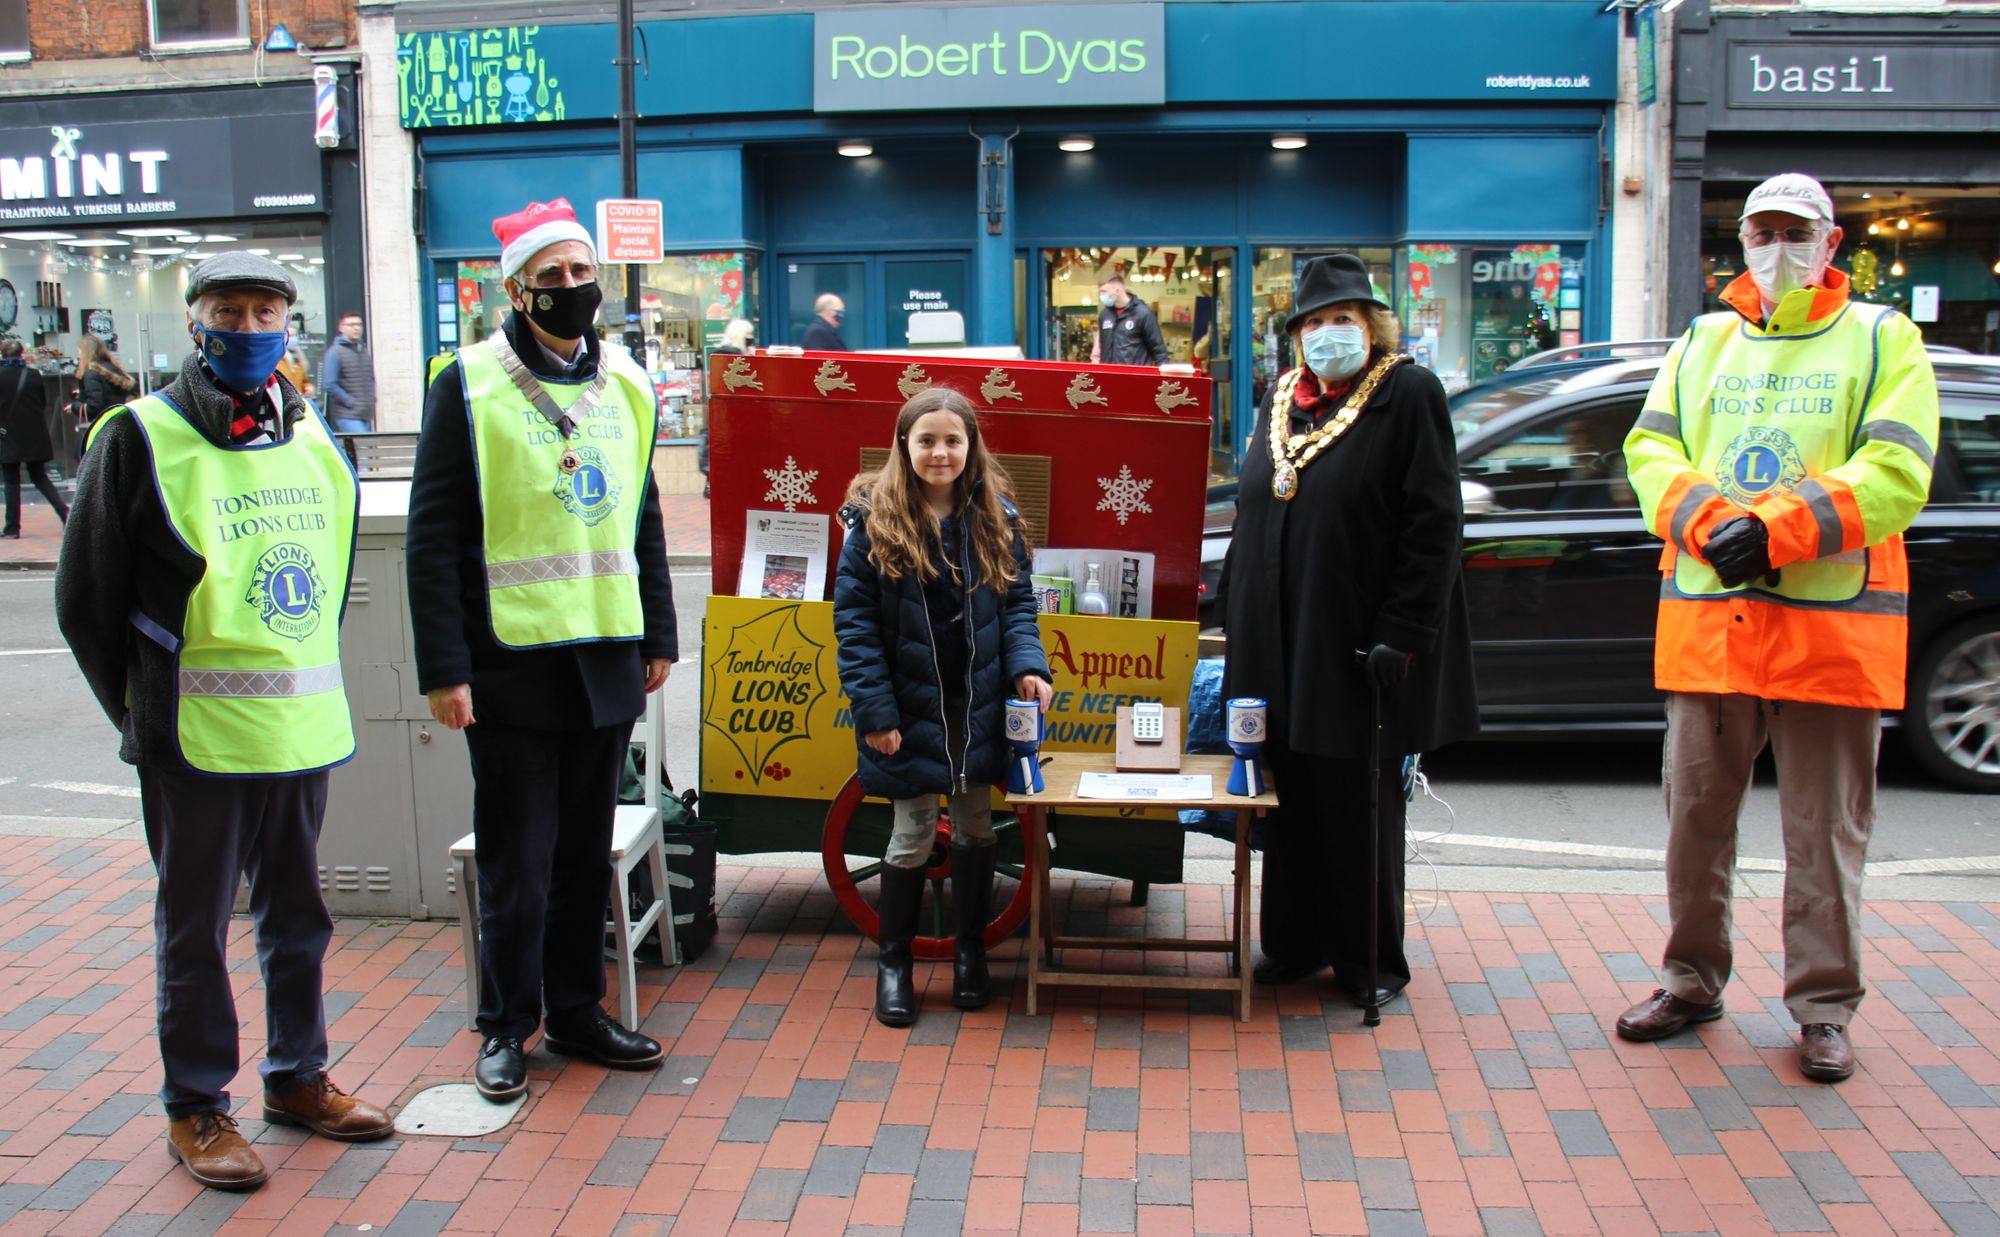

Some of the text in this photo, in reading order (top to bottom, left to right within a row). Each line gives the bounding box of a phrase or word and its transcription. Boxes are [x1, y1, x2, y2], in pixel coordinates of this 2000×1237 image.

[831, 30, 1147, 83] Robert Dyas
[1486, 75, 1591, 90] robertdyas.co.uk
[1749, 54, 1894, 93] basil
[0, 150, 168, 200] MINT
[0, 200, 176, 219] TRADITIONAL TURKISH BARBERS
[608, 205, 657, 217] COVID-19
[612, 223, 656, 235] Maintain
[613, 247, 656, 258] distance
[619, 236, 649, 246] social
[902, 301, 948, 311] use main
[908, 290, 942, 300] Please
[1714, 373, 1837, 393] TONBRIDGE
[1774, 396, 1833, 415] CLUB
[587, 424, 623, 440] CLUB
[1743, 451, 1769, 483] L
[580, 470, 601, 499] L
[212, 487, 322, 516] TONBRIDGE
[219, 513, 326, 543] LIONS CLUB
[264, 546, 310, 569] LIONS
[282, 573, 308, 607] L
[273, 612, 317, 633] INTERNATIONAL
[726, 650, 813, 682] Tonbridge
[1048, 629, 1167, 690] Appeal
[731, 680, 811, 706] LIONS
[728, 708, 796, 734] CLUB
